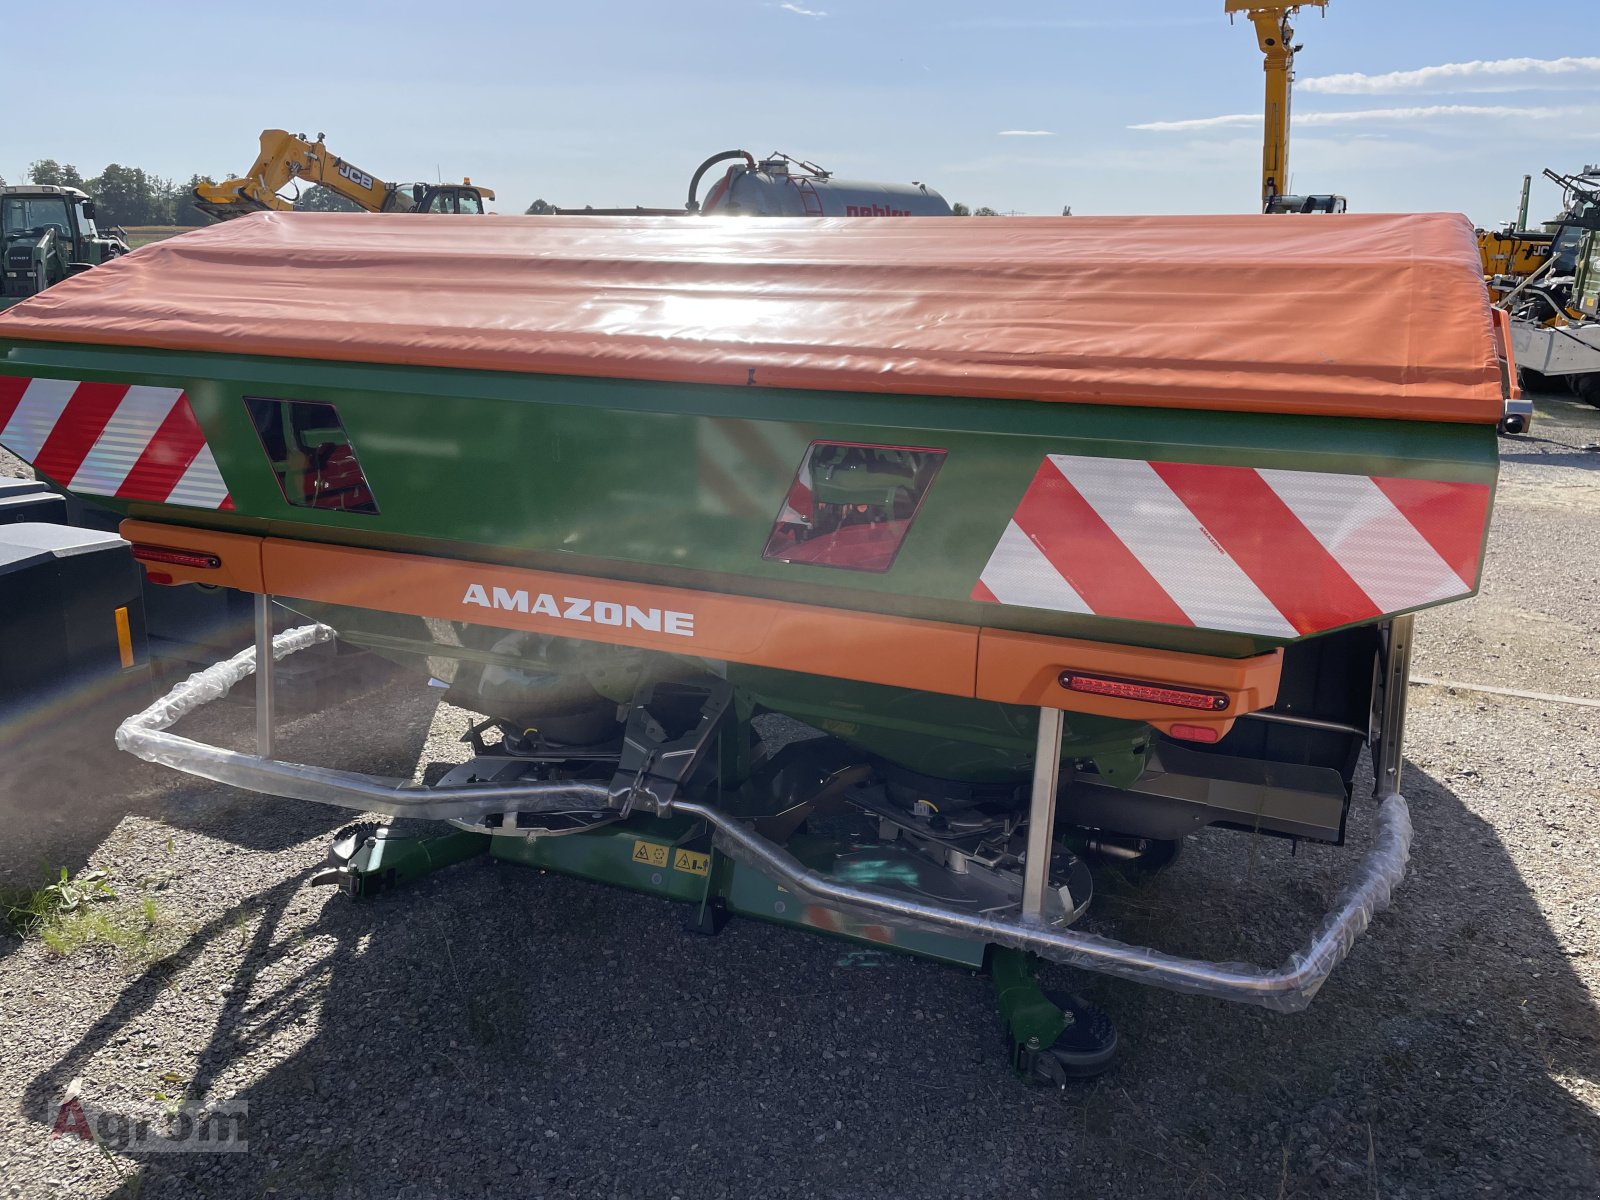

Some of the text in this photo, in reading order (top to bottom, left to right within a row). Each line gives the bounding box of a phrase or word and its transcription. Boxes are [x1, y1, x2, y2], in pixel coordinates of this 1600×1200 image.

[339, 164, 373, 190] JCB
[1533, 245, 1550, 256] JC
[462, 583, 694, 637] AMAZONE
